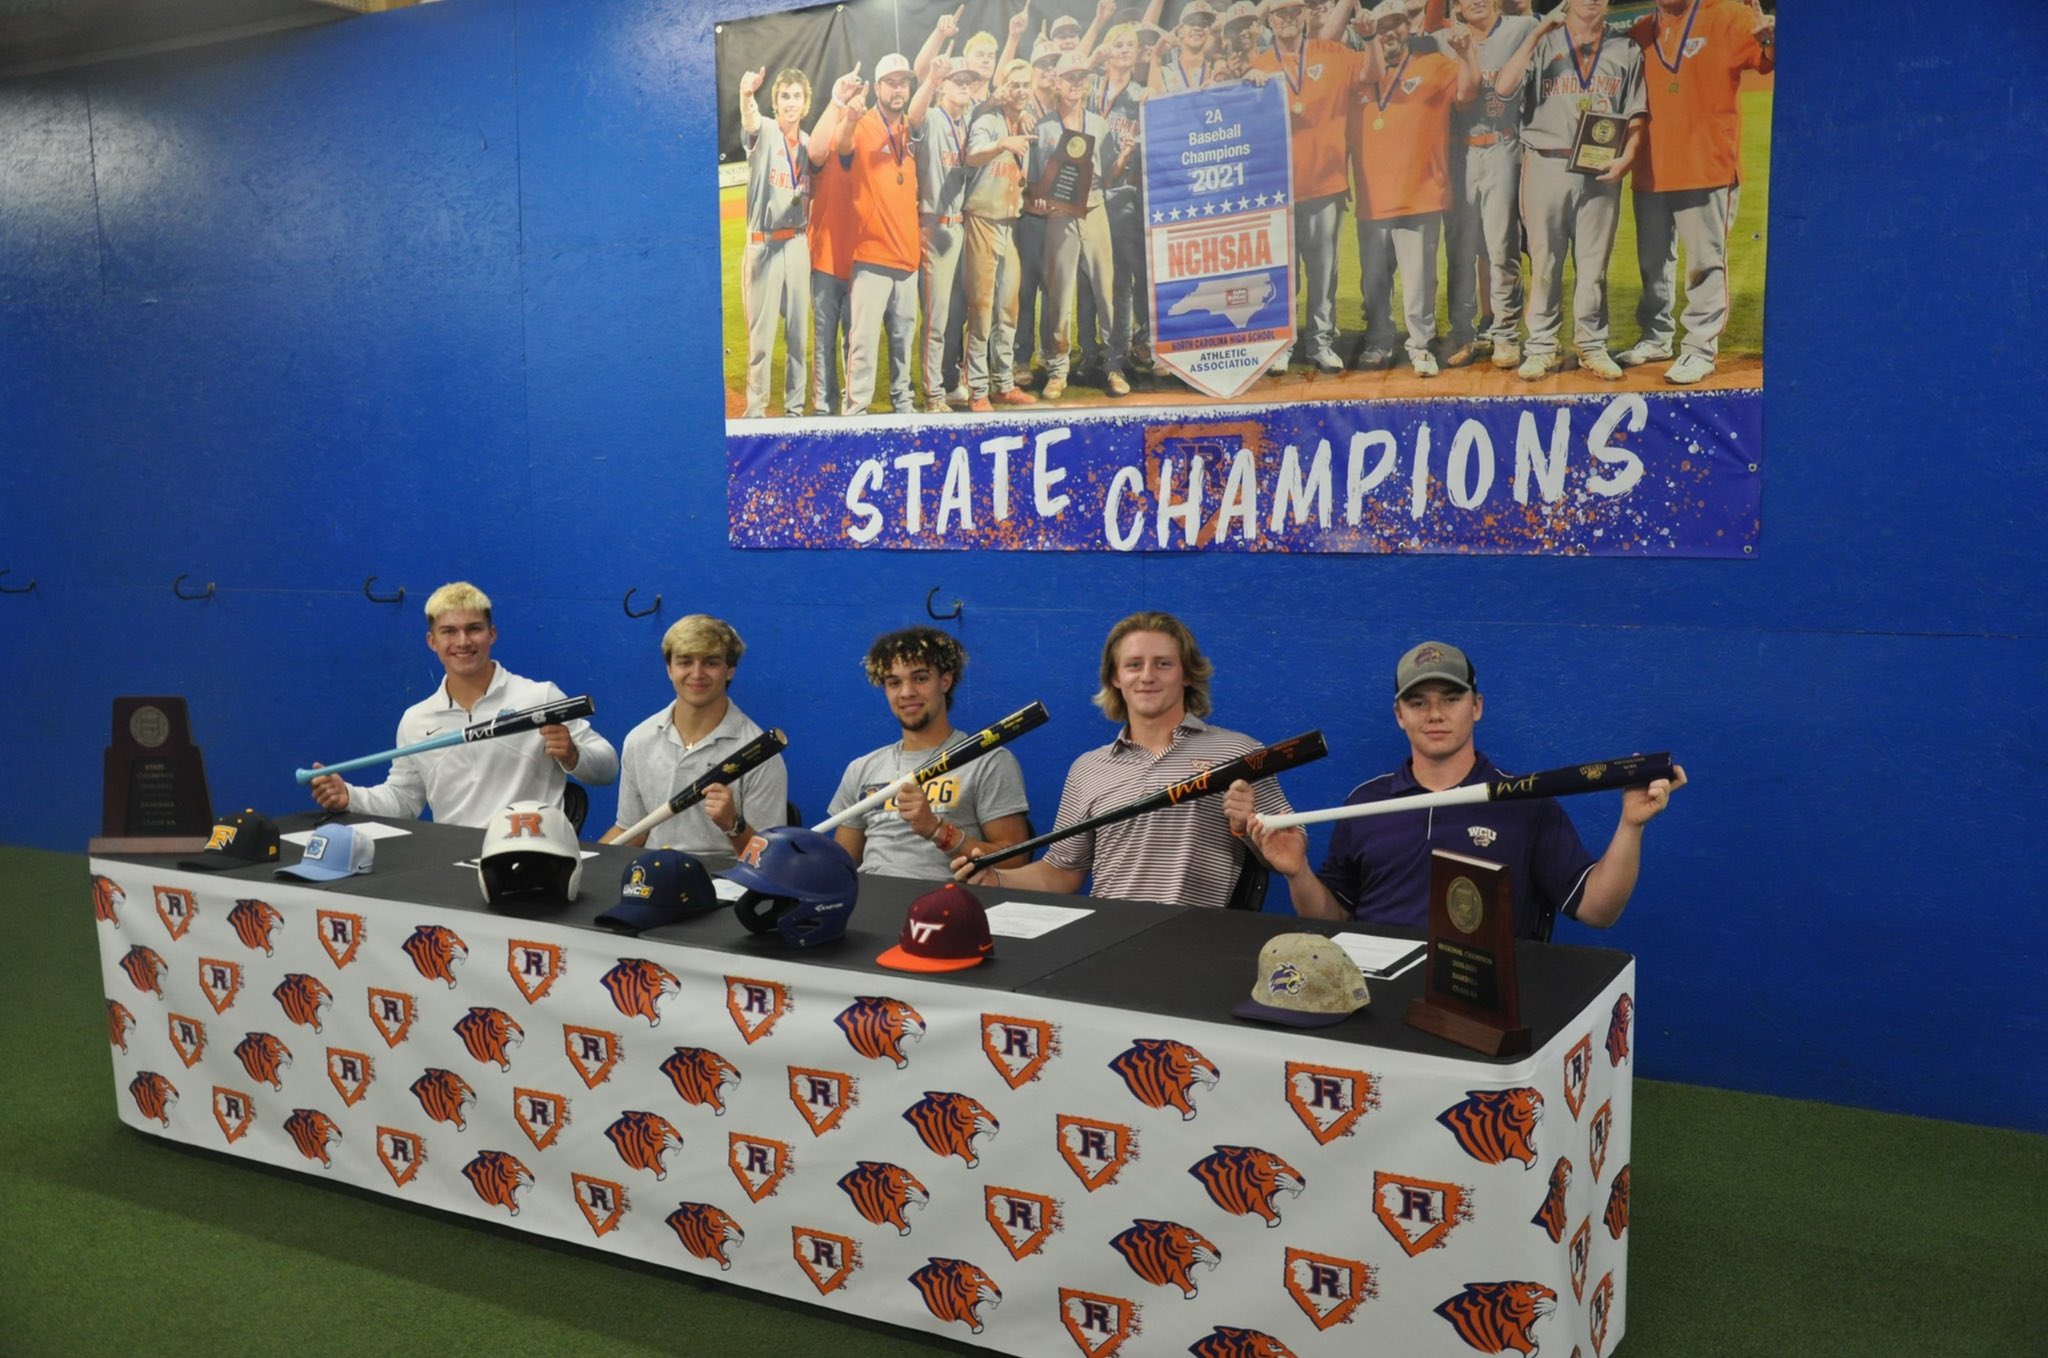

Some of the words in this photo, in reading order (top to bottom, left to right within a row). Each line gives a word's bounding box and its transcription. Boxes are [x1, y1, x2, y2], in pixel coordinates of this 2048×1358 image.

[1205, 109, 1223, 124] 2A
[1189, 124, 1241, 146] Baseball
[1182, 144, 1250, 165] Champions
[1190, 162, 1244, 193] 2021
[1168, 230, 1273, 278] NCHSAA
[1172, 340, 1194, 351] NORTH
[1195, 336, 1228, 349] CAROLINA
[1230, 333, 1246, 345] HIGH
[1247, 330, 1276, 342] SCHOOL
[1190, 357, 1259, 373] ASSOCIATION
[1200, 348, 1247, 362] ATHLETIC
[845, 427, 1072, 544] STATE
[1103, 394, 1648, 551] CHAMPIONS
[891, 780, 954, 808] CG
[204, 825, 238, 850] F
[503, 812, 547, 838] R
[1467, 825, 1497, 841] WCU
[737, 835, 769, 867] R
[623, 884, 653, 899] UNCG
[167, 895, 182, 916] R
[331, 919, 349, 942] R
[910, 918, 945, 943] VT
[523, 951, 544, 976] R
[211, 967, 228, 990] R
[382, 998, 400, 1022] R
[743, 986, 767, 1013] R
[180, 1023, 195, 1045] R
[1003, 1027, 1029, 1057] R
[580, 1036, 601, 1062] R
[340, 1057, 358, 1081] R
[807, 1078, 831, 1106] R
[1312, 1077, 1343, 1111] R
[225, 1095, 240, 1118] R
[529, 1100, 550, 1126] R
[391, 1137, 410, 1161] R
[1079, 1129, 1107, 1160] R
[745, 1144, 767, 1174] R
[588, 1186, 609, 1209] R
[1397, 1187, 1432, 1223] R
[1006, 1199, 1033, 1230] R
[811, 1238, 836, 1268] R
[1311, 1263, 1342, 1298] R
[1081, 1300, 1110, 1334] R
